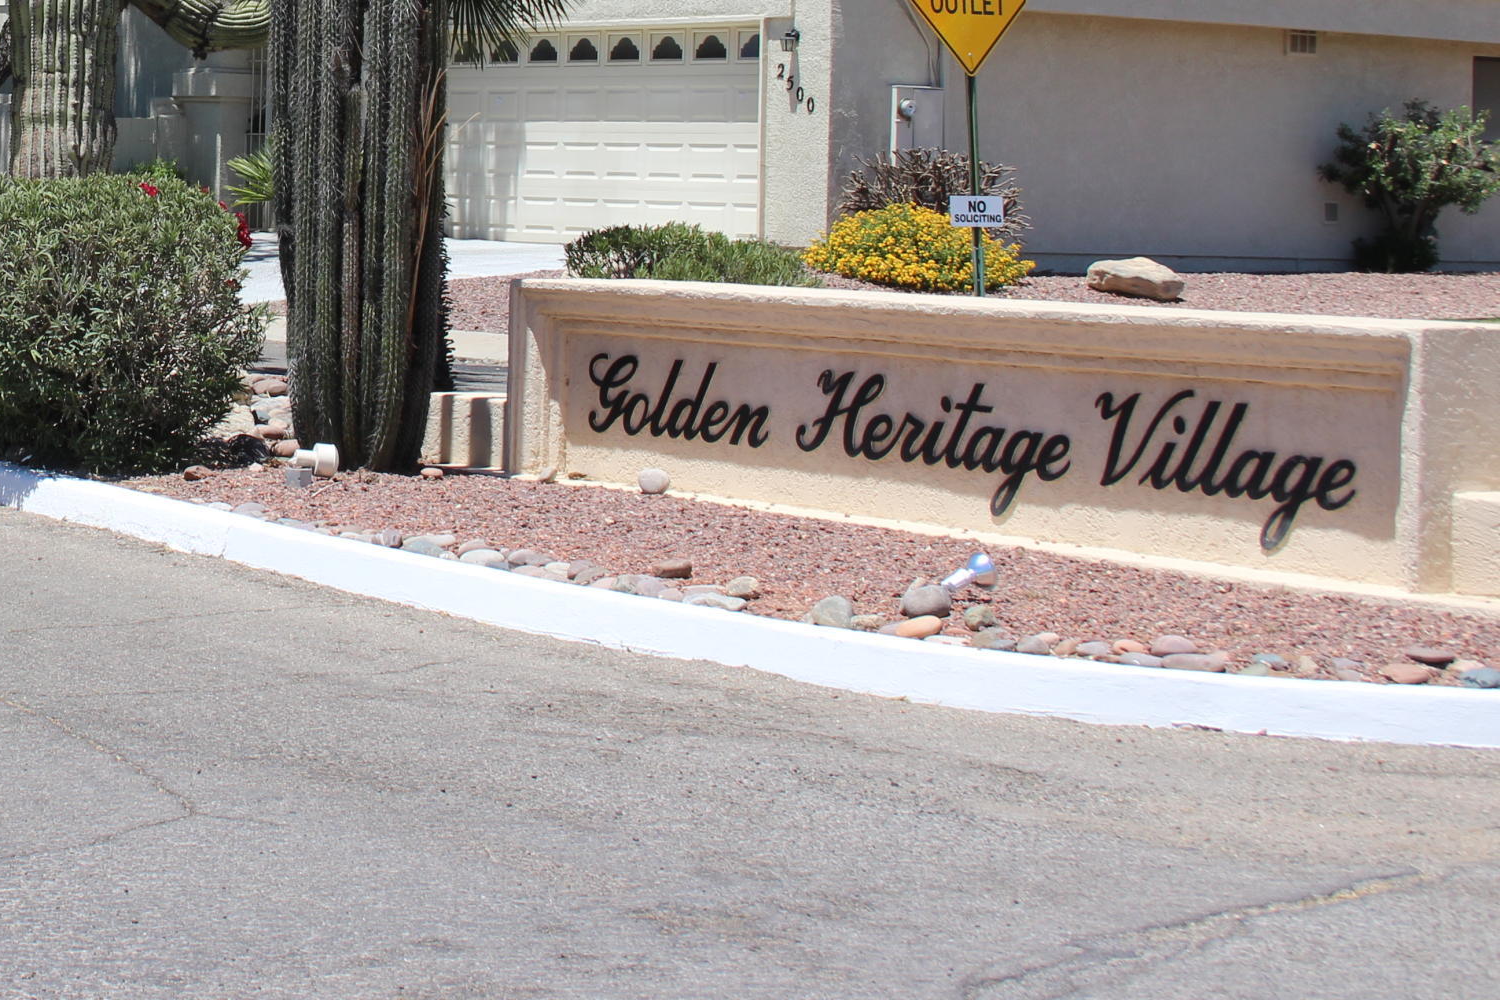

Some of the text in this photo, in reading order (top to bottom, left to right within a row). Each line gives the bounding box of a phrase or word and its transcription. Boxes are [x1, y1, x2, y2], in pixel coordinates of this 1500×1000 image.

[777, 63, 815, 113] 2500
[954, 213, 1002, 223] SOLICITING
[968, 200, 987, 213] NO
[589, 352, 1358, 551] Golden Heritage Village
